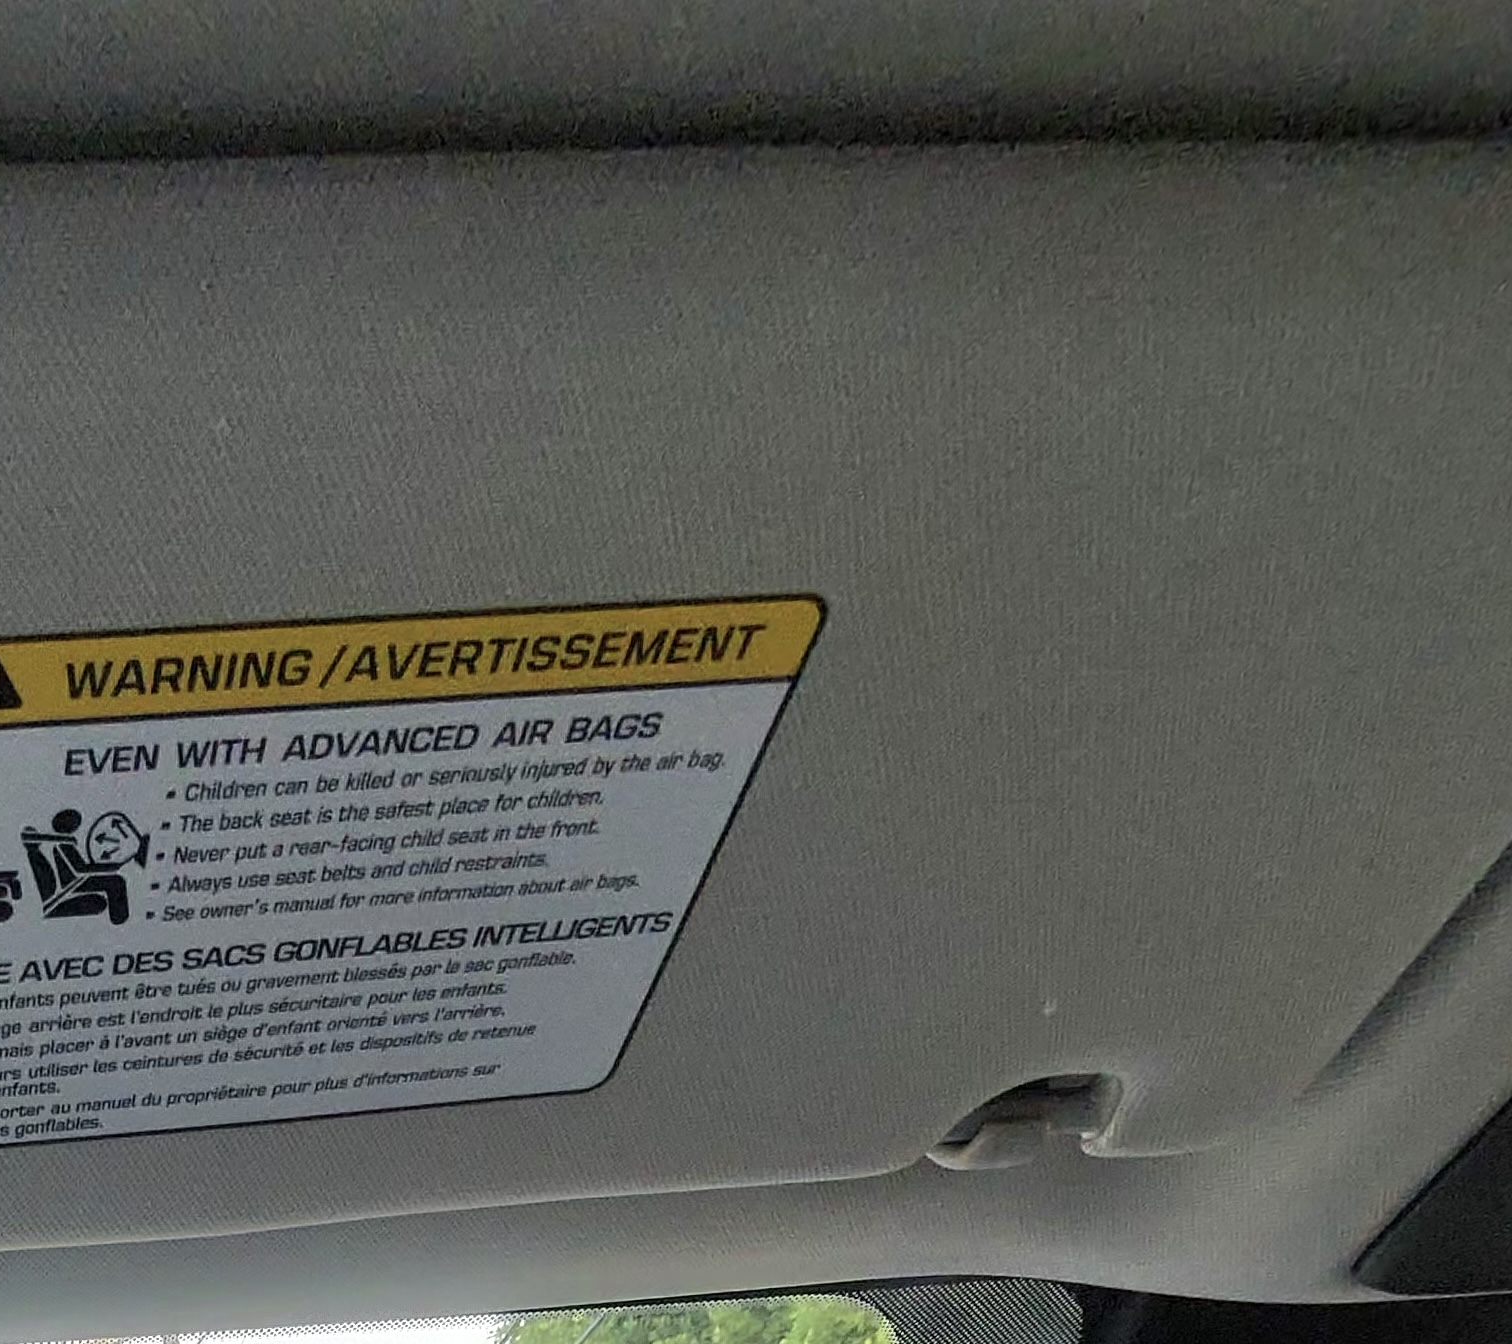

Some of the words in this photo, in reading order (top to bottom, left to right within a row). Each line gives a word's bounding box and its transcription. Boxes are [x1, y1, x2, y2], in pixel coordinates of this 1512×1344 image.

[64, 743, 160, 776] EVEN
[176, 736, 267, 768] WITH
[281, 723, 479, 761] ADVANCED
[491, 718, 554, 747] AIR
[564, 711, 664, 743] BAGS
[184, 779, 267, 802] Children
[273, 780, 308, 796] can
[344, 768, 395, 791] killed
[427, 762, 518, 786] seriously
[520, 757, 589, 782] injured
[619, 753, 651, 772] the
[655, 751, 683, 770] air
[179, 813, 213, 833] The
[218, 808, 264, 831] back
[269, 808, 312, 827] seat
[338, 803, 369, 822] the
[373, 795, 435, 820] safest
[436, 796, 490, 820] place
[494, 793, 523, 812] for
[173, 845, 231, 864] Never
[233, 842, 268, 862] put
[288, 833, 397, 856] rear-facing
[399, 827, 445, 849] child
[447, 825, 490, 845] seat
[515, 819, 547, 840] the
[161, 904, 195, 922] See
[199, 897, 269, 919] owner's
[272, 893, 336, 913] manual
[339, 892, 365, 909] for
[368, 891, 414, 906] more
[417, 881, 514, 903] information
[517, 877, 566, 895] about
[568, 876, 593, 891] air
[166, 874, 232, 895] Always
[237, 873, 270, 888] use
[273, 868, 316, 886] seat
[320, 863, 366, 882] belts
[370, 859, 406, 879] and
[408, 856, 453, 876] child
[18, 955, 104, 983] AVEC
[112, 950, 174, 975] DES
[181, 942, 266, 970] SACS
[273, 928, 467, 963] GONFLABLES
[473, 912, 674, 948] INTELLIGENTS
[59, 986, 129, 1010] peuvent
[134, 982, 172, 999] être
[177, 977, 216, 996] tués
[245, 969, 340, 994] gravement
[342, 962, 407, 982] blessés
[409, 963, 442, 980] par
[463, 959, 494, 973] sac
[27, 1013, 92, 1033] arrière
[96, 1012, 125, 1027] est
[130, 1005, 202, 1024] l'endroit
[226, 1000, 263, 1020] plus
[267, 992, 363, 1013] sécuritaire
[366, 990, 408, 1009] pour
[411, 987, 437, 1001] les
[38, 1039, 94, 1059] placer
[114, 1032, 172, 1048] l'avant
[202, 1024, 247, 1043] siège
[252, 1019, 322, 1037] d'enfant
[326, 1010, 387, 1031] orienté
[392, 1011, 429, 1025] vers
[28, 1062, 88, 1079] utiliser
[92, 1058, 118, 1073] les
[122, 1053, 203, 1071] ceintures
[233, 1040, 304, 1061] sécurité
[330, 1038, 354, 1053] les
[359, 1030, 443, 1052] dispositifs
[471, 1024, 536, 1040] retenue
[75, 1093, 136, 1112] manuel
[165, 1083, 267, 1107] propriétaire
[270, 1081, 312, 1099] pour
[313, 1076, 348, 1094] plus
[352, 1066, 468, 1087] d'informations
[471, 1063, 501, 1076] sur
[14, 1116, 103, 1138] gonflables.
